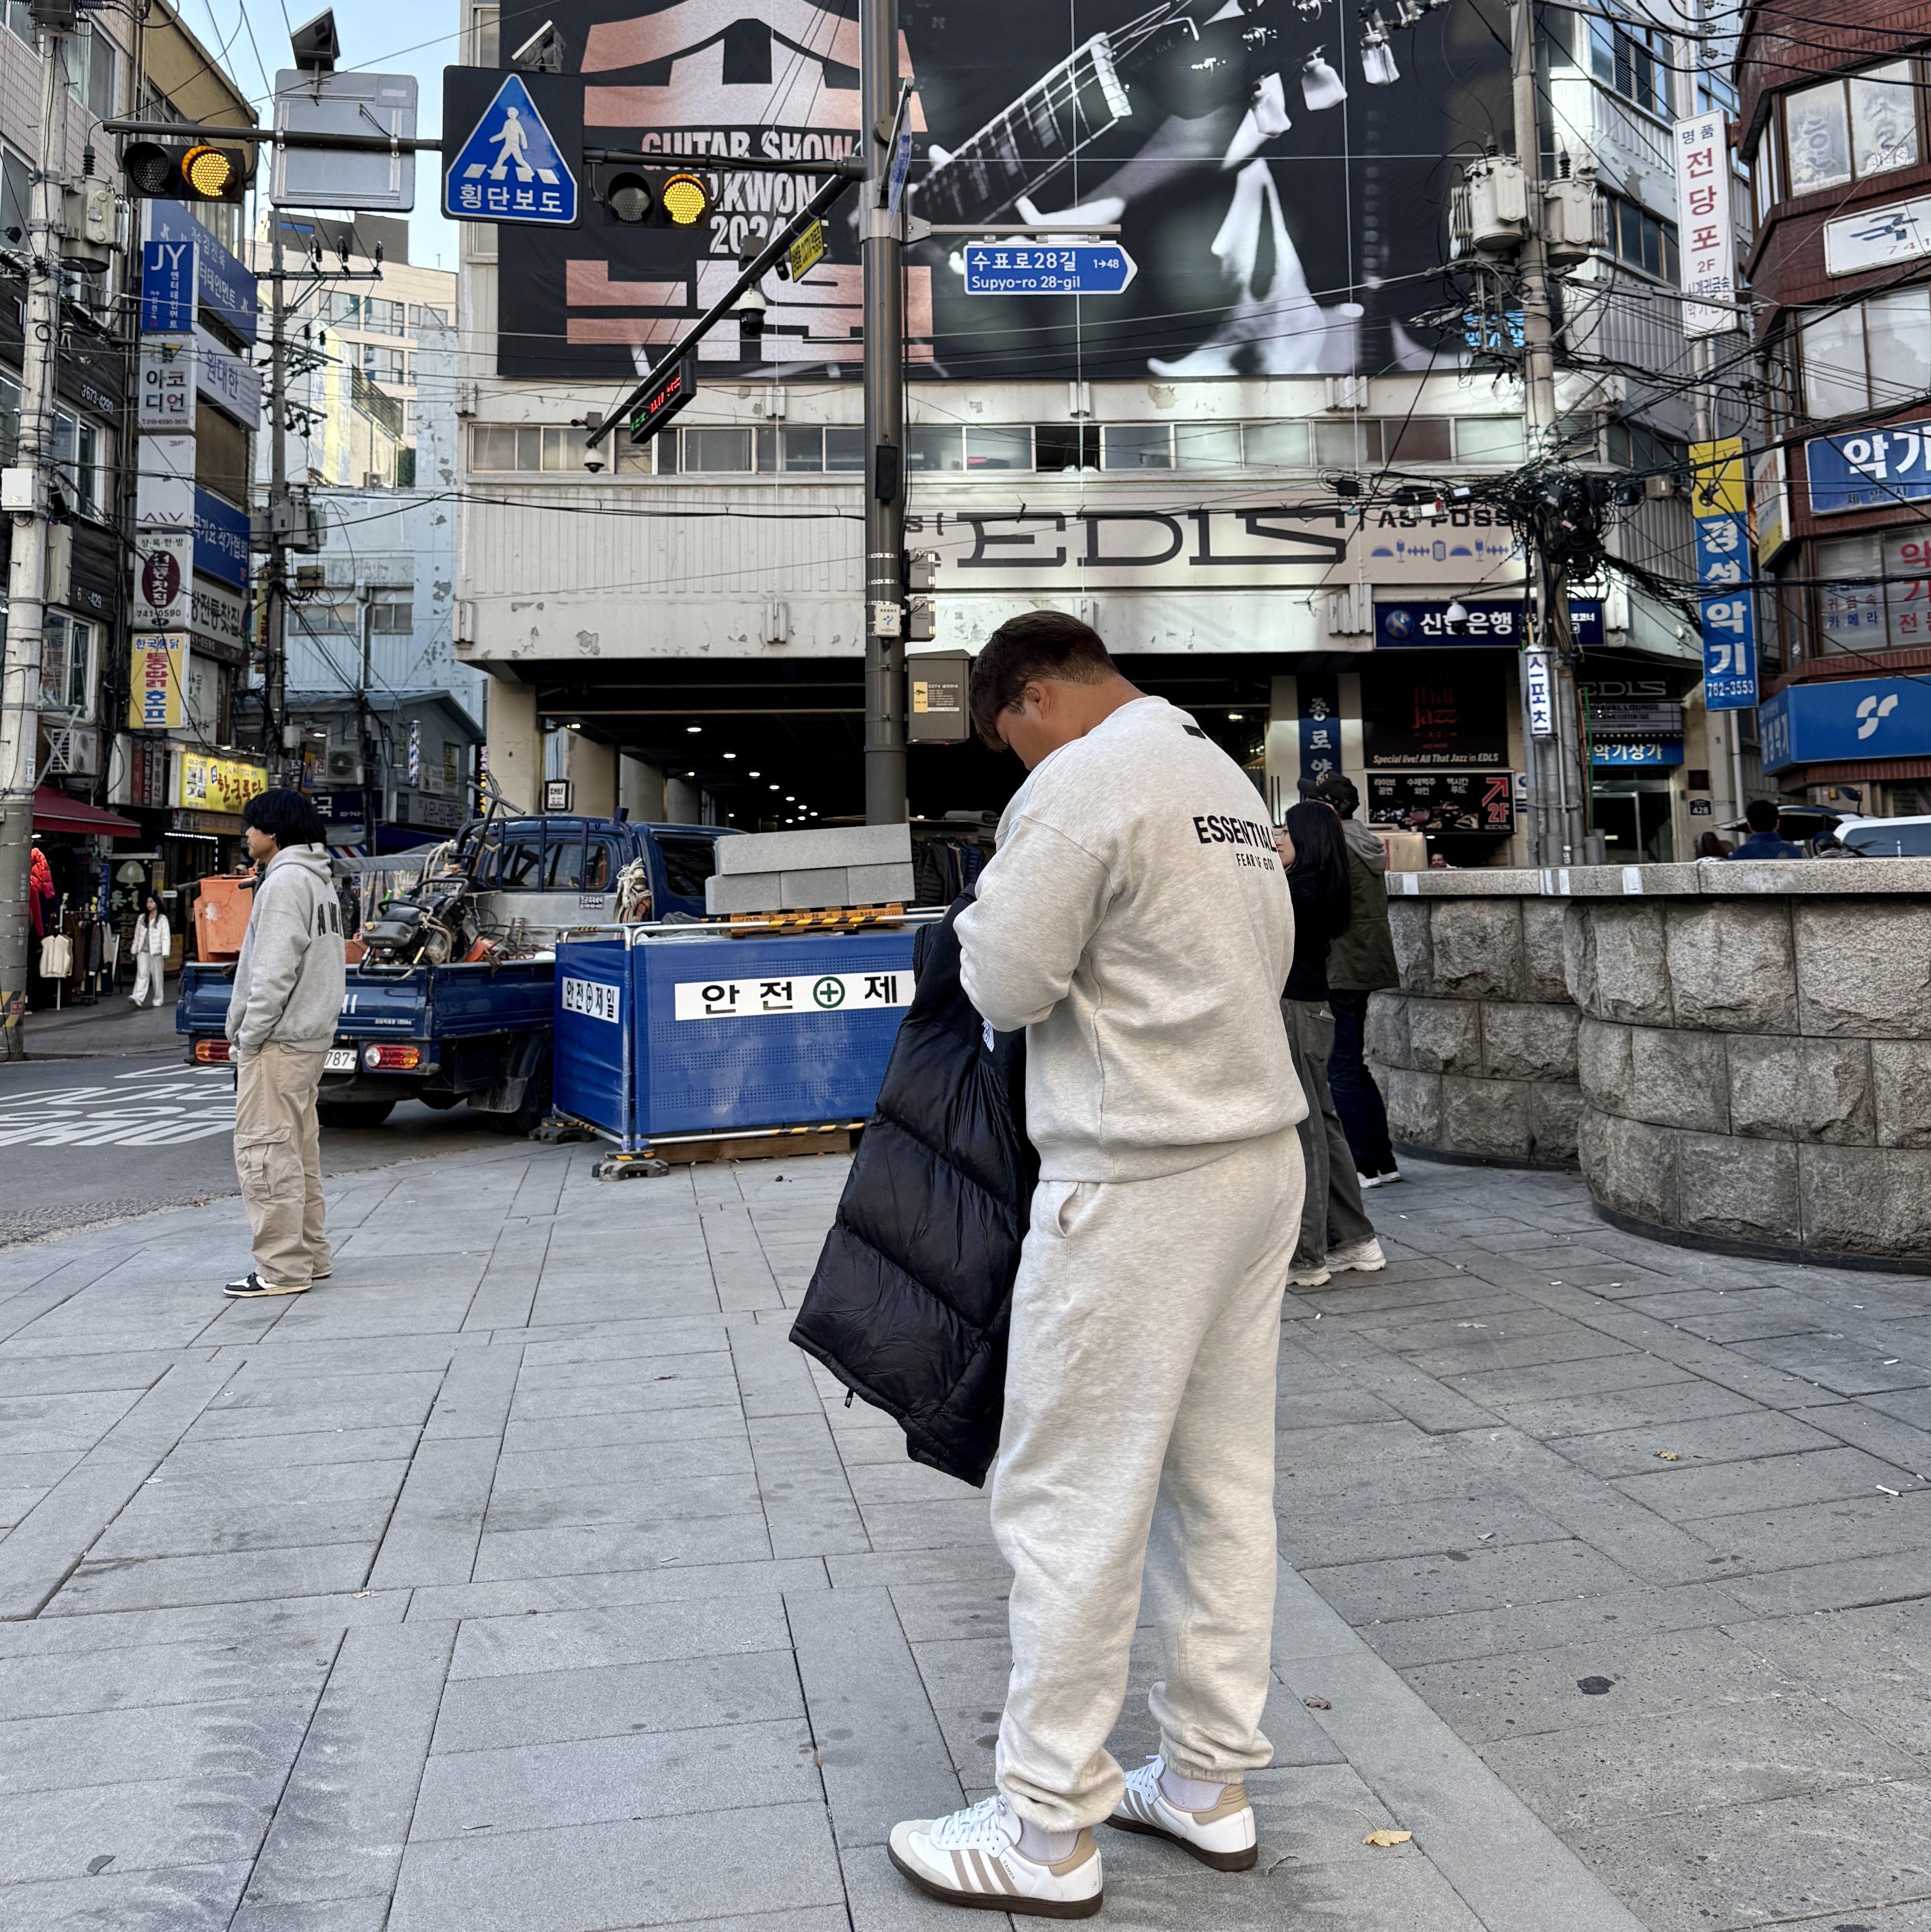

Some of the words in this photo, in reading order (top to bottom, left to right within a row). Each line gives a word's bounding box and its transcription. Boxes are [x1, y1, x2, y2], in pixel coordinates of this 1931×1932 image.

[1682, 124, 1714, 144] 명품
[460, 184, 563, 213] 횡단보도
[1686, 148, 1720, 253] 전당포
[151, 244, 186, 271] JY
[971, 251, 1077, 272] 수표로28길
[1697, 258, 1715, 273] 2F
[972, 276, 1037, 291] Supyo-ro
[1040, 276, 1080, 291] 28-gil
[147, 369, 186, 389] 아코
[146, 393, 184, 413] 디언
[1829, 611, 1878, 628] 카메라
[1529, 656, 1550, 732] 스포츠
[1707, 680, 1754, 697] 762-3553
[144, 690, 167, 725] 호프
[1373, 755, 1401, 765] Special
[1420, 754, 1431, 763] All
[1432, 754, 1449, 763] That
[1450, 754, 1468, 762] Jazz
[1469, 753, 1476, 761] in
[1477, 753, 1499, 762] EDLS
[1488, 803, 1510, 823] 2F
[1236, 853, 1256, 867] FEAR
[701, 982, 793, 1014] 안전
[1003, 1860, 1015, 1880] SAMBA
